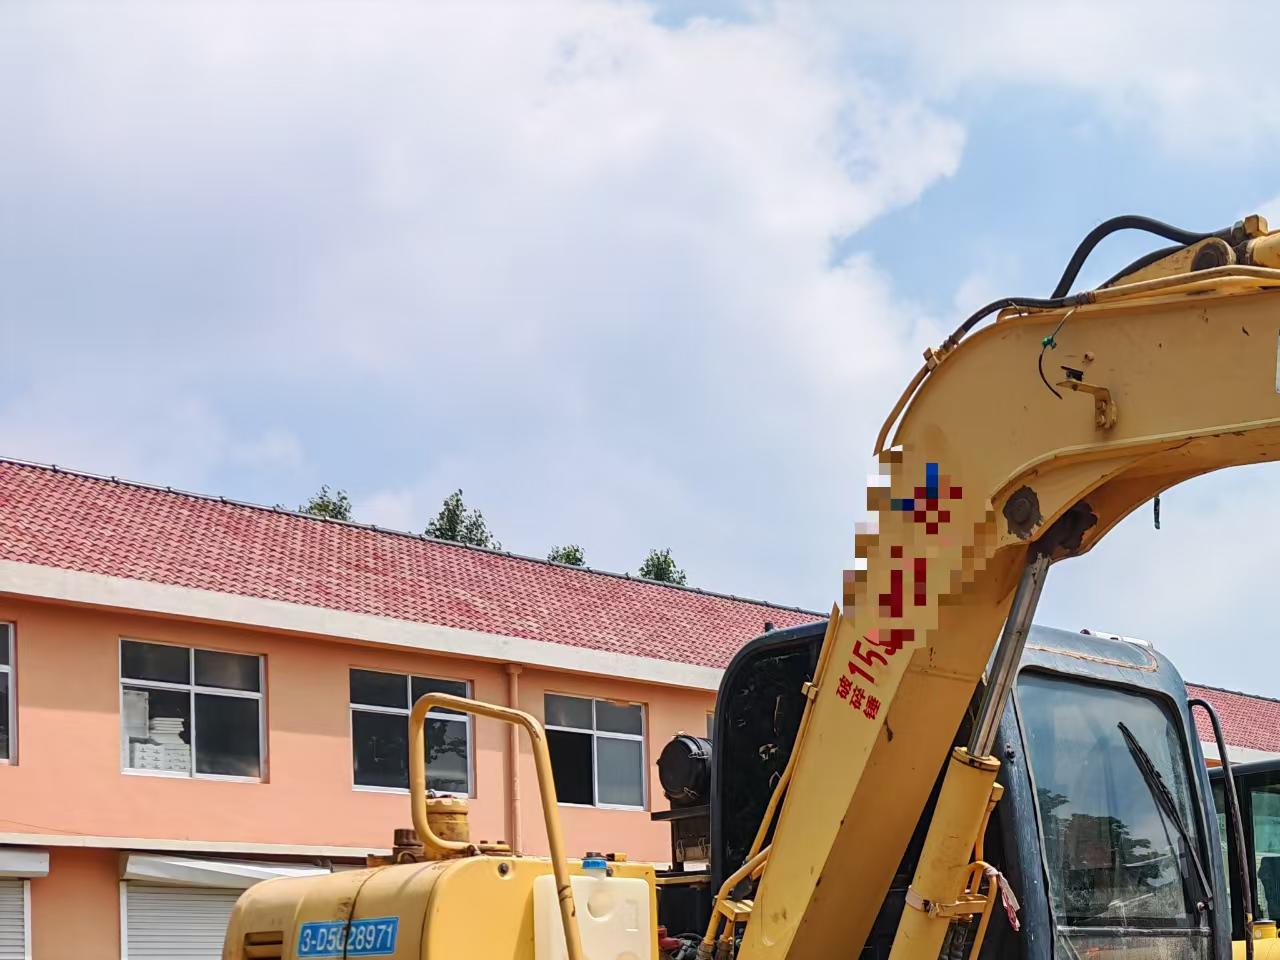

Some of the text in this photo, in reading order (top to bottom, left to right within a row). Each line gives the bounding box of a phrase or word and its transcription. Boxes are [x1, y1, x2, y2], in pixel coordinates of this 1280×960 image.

[836, 674, 881, 720] 破碎锤
[301, 924, 393, 952] 3-D5028971
